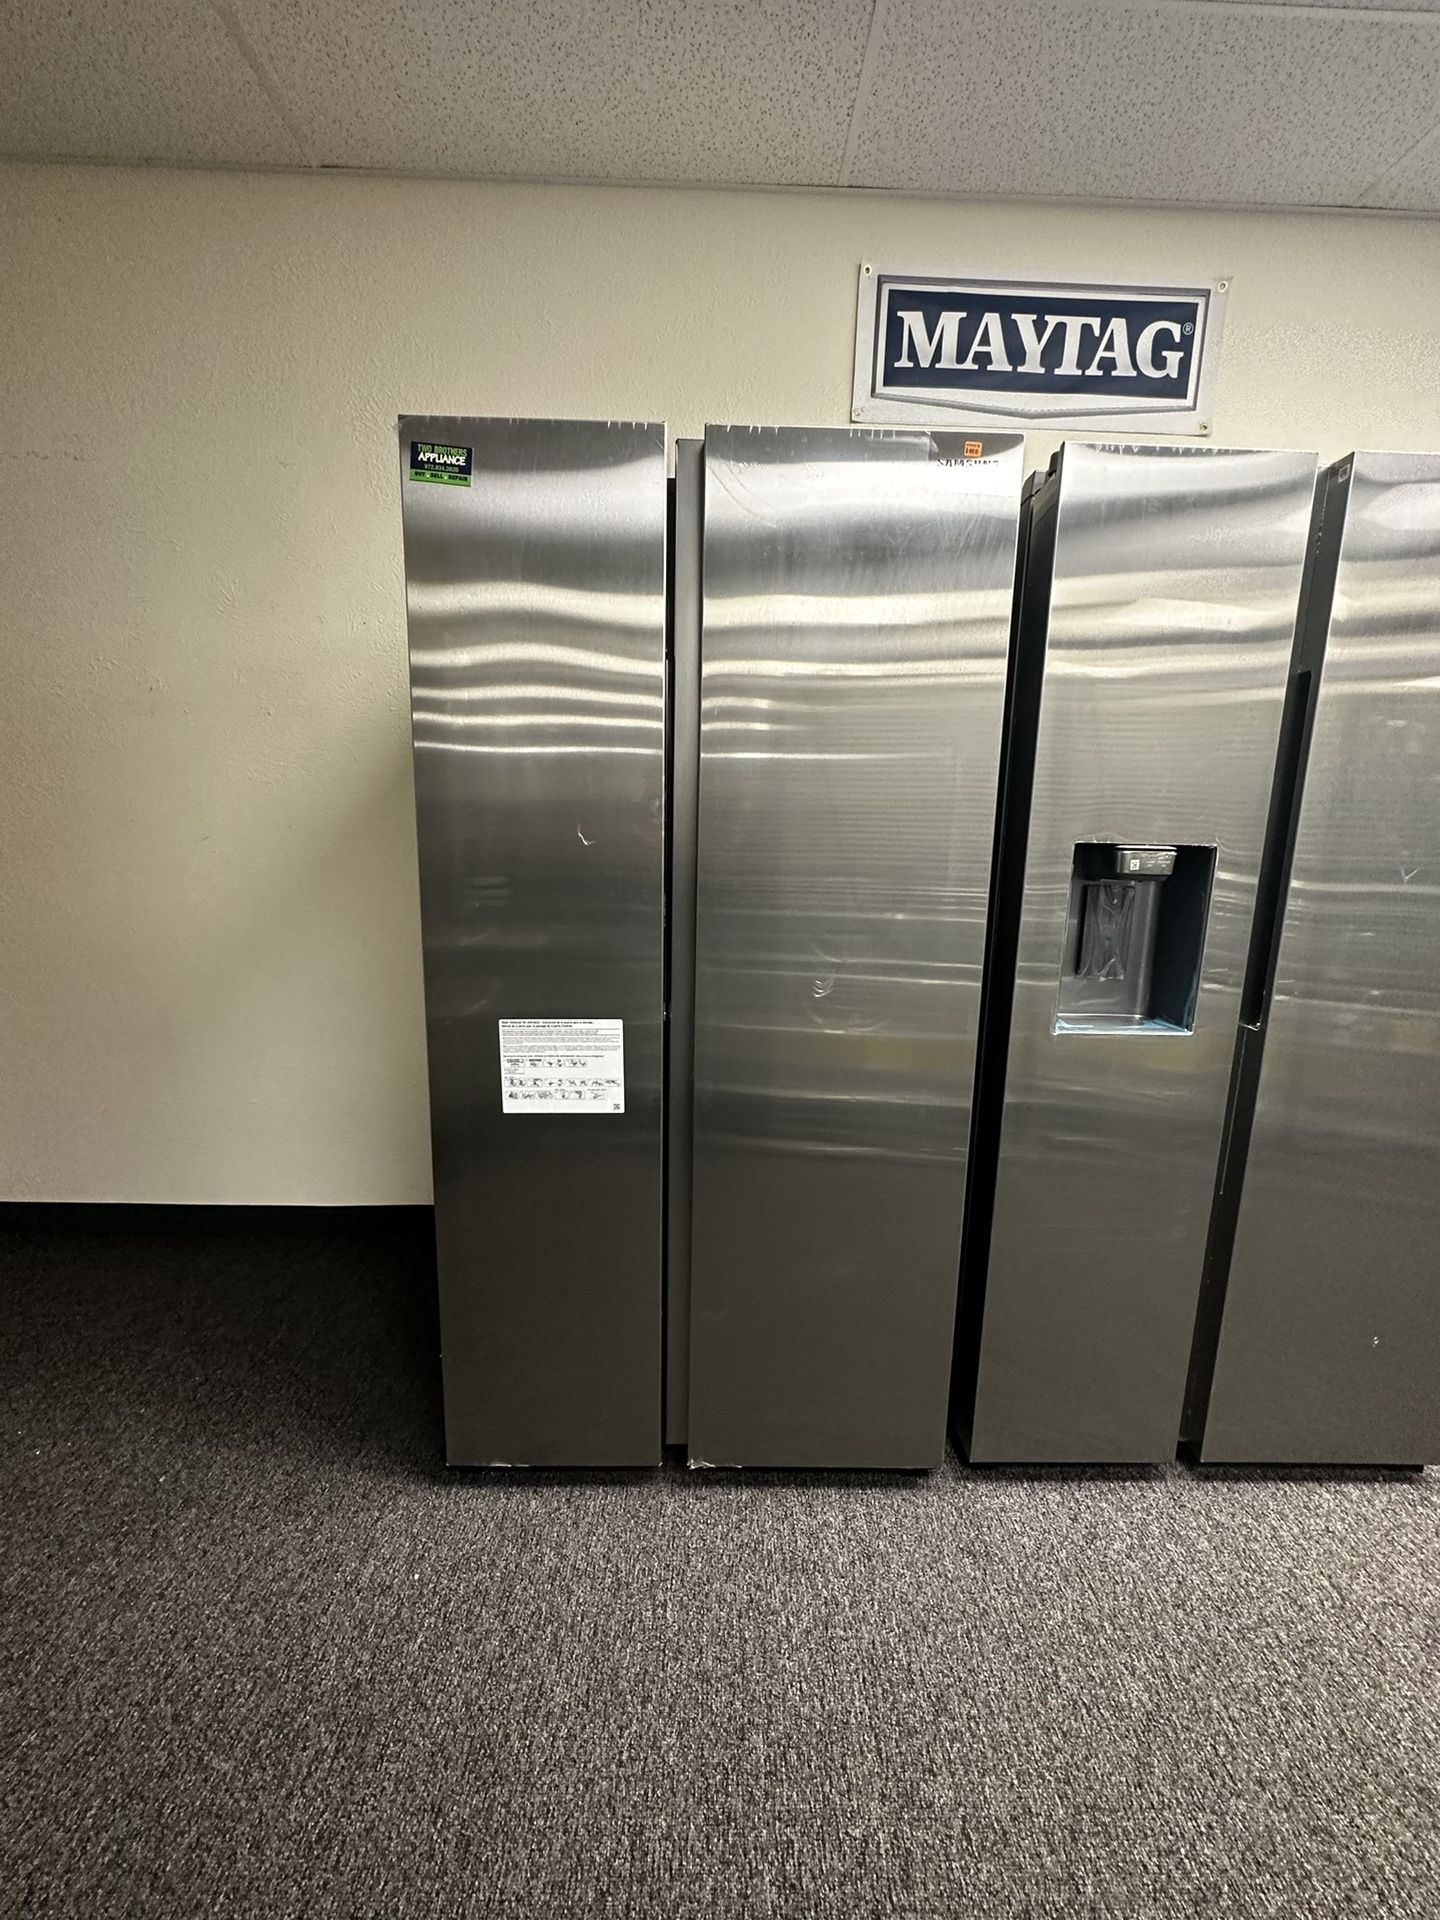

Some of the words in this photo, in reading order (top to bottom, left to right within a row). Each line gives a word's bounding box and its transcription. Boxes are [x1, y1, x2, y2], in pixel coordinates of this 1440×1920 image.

[417, 443, 432, 453] TWO
[433, 445, 468, 457] BROTHERS
[417, 451, 466, 466] APPLIANCE
